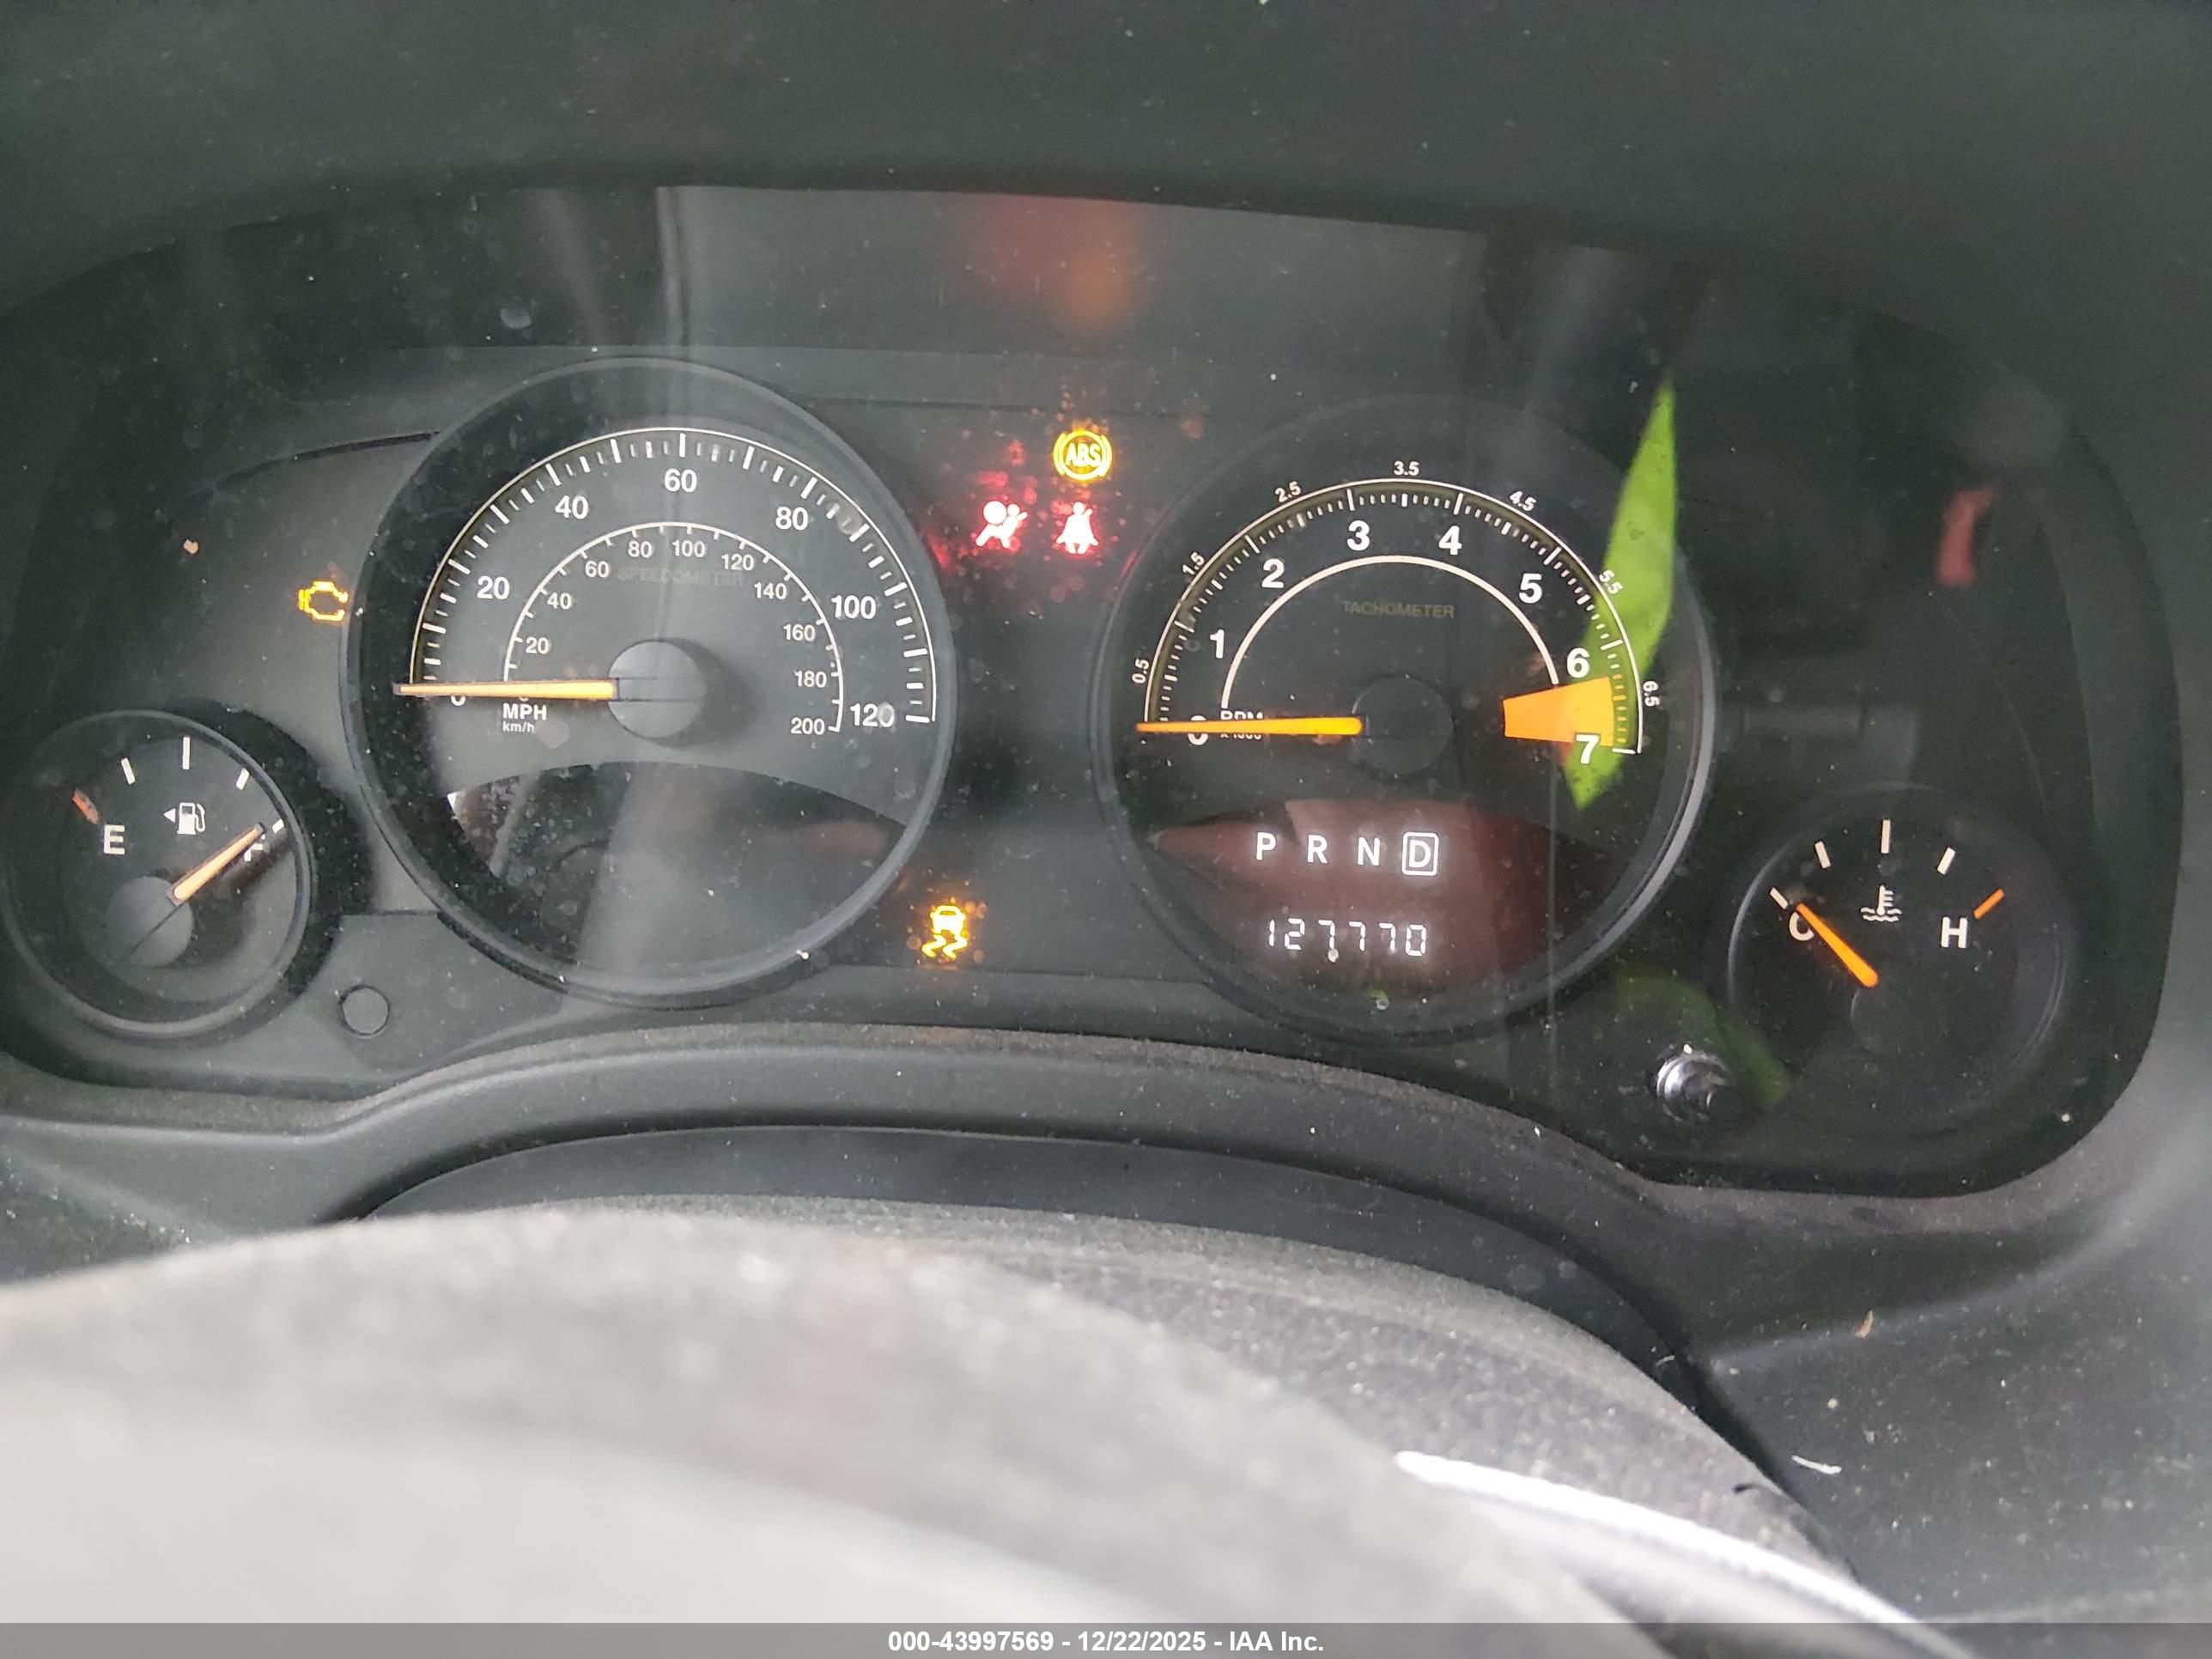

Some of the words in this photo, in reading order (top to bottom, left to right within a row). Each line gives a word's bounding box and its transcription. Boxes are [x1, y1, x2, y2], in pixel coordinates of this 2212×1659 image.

[1065, 442, 1101, 468] ABS
[664, 468, 697, 493] 60
[1394, 461, 1420, 477] 3.5
[1274, 481, 1302, 503] 2.5
[1509, 491, 1537, 512] 4.5
[555, 495, 589, 520] 40
[775, 507, 809, 531] 80
[1346, 520, 1370, 551] 3
[1438, 526, 1462, 556] 4
[628, 541, 653, 558] 80
[672, 540, 706, 558] 100
[585, 561, 611, 579] 60
[721, 554, 755, 572] 120
[1182, 551, 1205, 576] 1.5
[1261, 558, 1285, 589] 2
[477, 576, 510, 600] 20
[754, 583, 787, 600] 140
[1518, 573, 1543, 604] 5
[1599, 569, 1624, 595] 5.5
[547, 592, 572, 611] 40
[831, 595, 877, 620] 100
[1343, 600, 1455, 619] TACHOMETER
[783, 624, 816, 641] 160
[1210, 629, 1225, 659] 1
[526, 637, 550, 654] 20
[1132, 659, 1150, 684] 0.5
[1567, 647, 1590, 678] 6
[794, 670, 828, 688] 180
[1643, 680, 1661, 708] 6.5
[502, 703, 548, 721] MPH
[850, 702, 895, 728] 120
[502, 720, 535, 733] km/h
[790, 718, 825, 735] 200
[1575, 732, 1601, 764] 7
[103, 823, 126, 855] E
[1255, 831, 1277, 861] P
[1307, 835, 1328, 864] R
[1357, 836, 1381, 866] N
[1408, 839, 1431, 868] D
[1268, 918, 1426, 957] 127770
[1789, 911, 1814, 941] C
[1941, 916, 1968, 949] H
